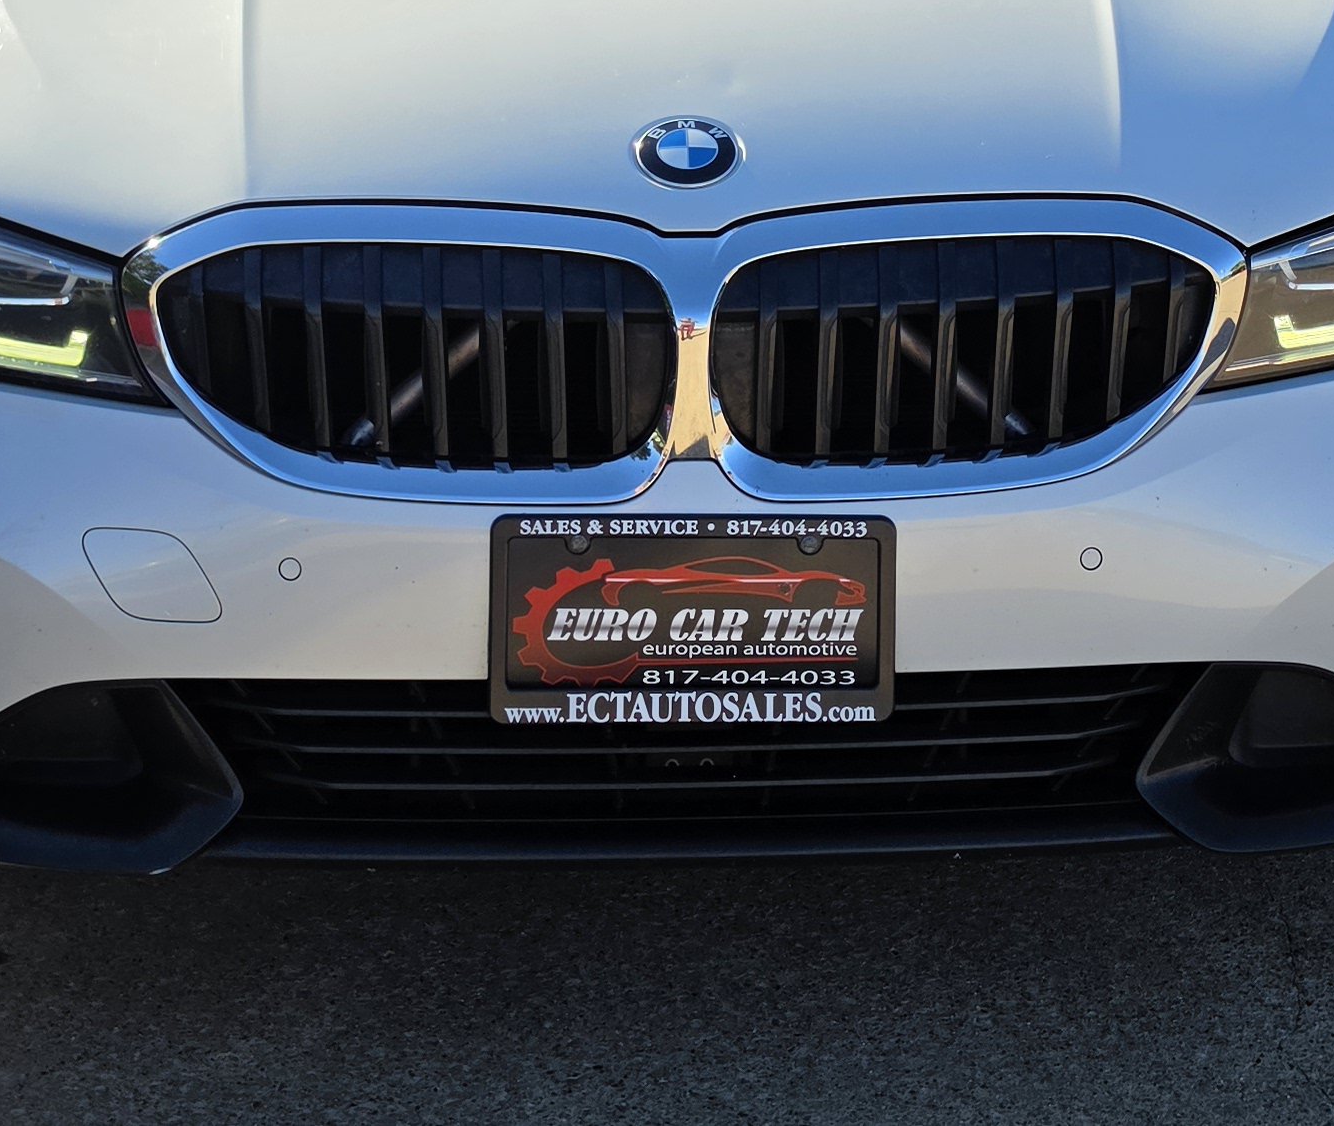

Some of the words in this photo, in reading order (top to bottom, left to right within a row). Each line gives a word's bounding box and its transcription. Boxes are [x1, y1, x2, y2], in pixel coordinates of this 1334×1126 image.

[648, 120, 728, 140] BMW
[519, 519, 582, 535] SALES
[586, 519, 604, 535] &
[609, 519, 699, 535] SERVICE
[726, 520, 868, 538] 817-404-4033
[547, 607, 658, 642] EURO
[669, 607, 749, 642] CAR
[761, 608, 864, 642] TECH
[642, 643, 737, 659] european
[743, 642, 858, 657] automotive
[642, 669, 856, 685] 817-404-4033
[504, 691, 876, 724] www.ECTAUTOSALES.com
